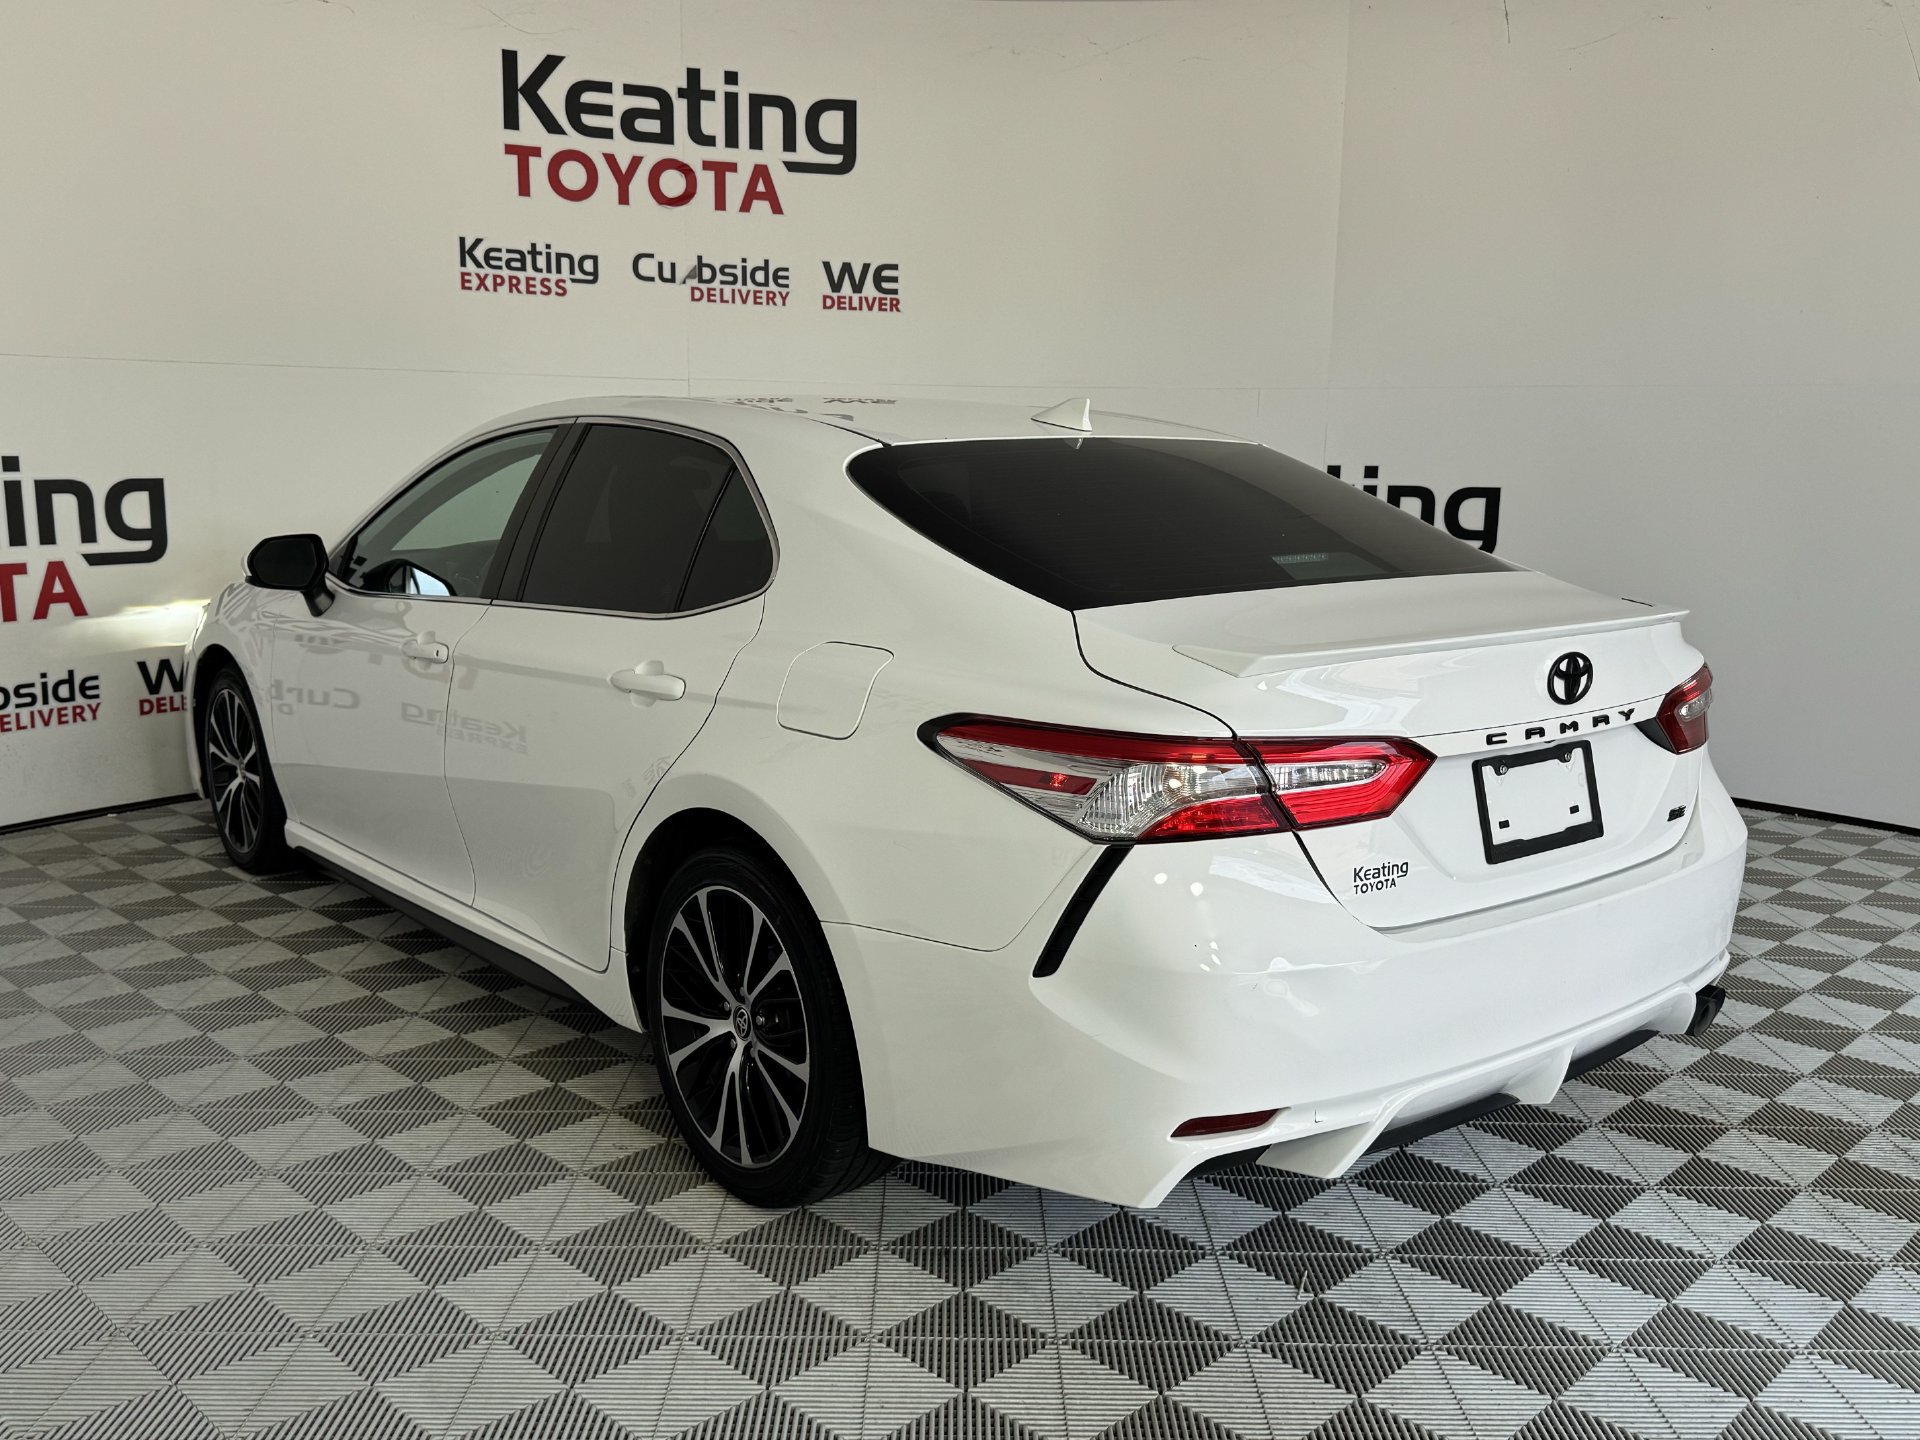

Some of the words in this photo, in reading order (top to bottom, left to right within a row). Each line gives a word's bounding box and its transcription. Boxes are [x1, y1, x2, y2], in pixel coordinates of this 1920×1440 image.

[501, 48, 857, 175] Keating
[504, 143, 784, 216] TOYOTA
[459, 236, 599, 285] Keating
[632, 253, 790, 288] Cubside
[460, 271, 568, 297] EXPRESS
[822, 261, 899, 295] WE
[690, 286, 790, 307] DELIVERY
[822, 294, 901, 313] DELIVER
[1486, 708, 1635, 745] CAMRY
[1353, 861, 1409, 883] Keating
[1353, 877, 1397, 895] TOYOTA
